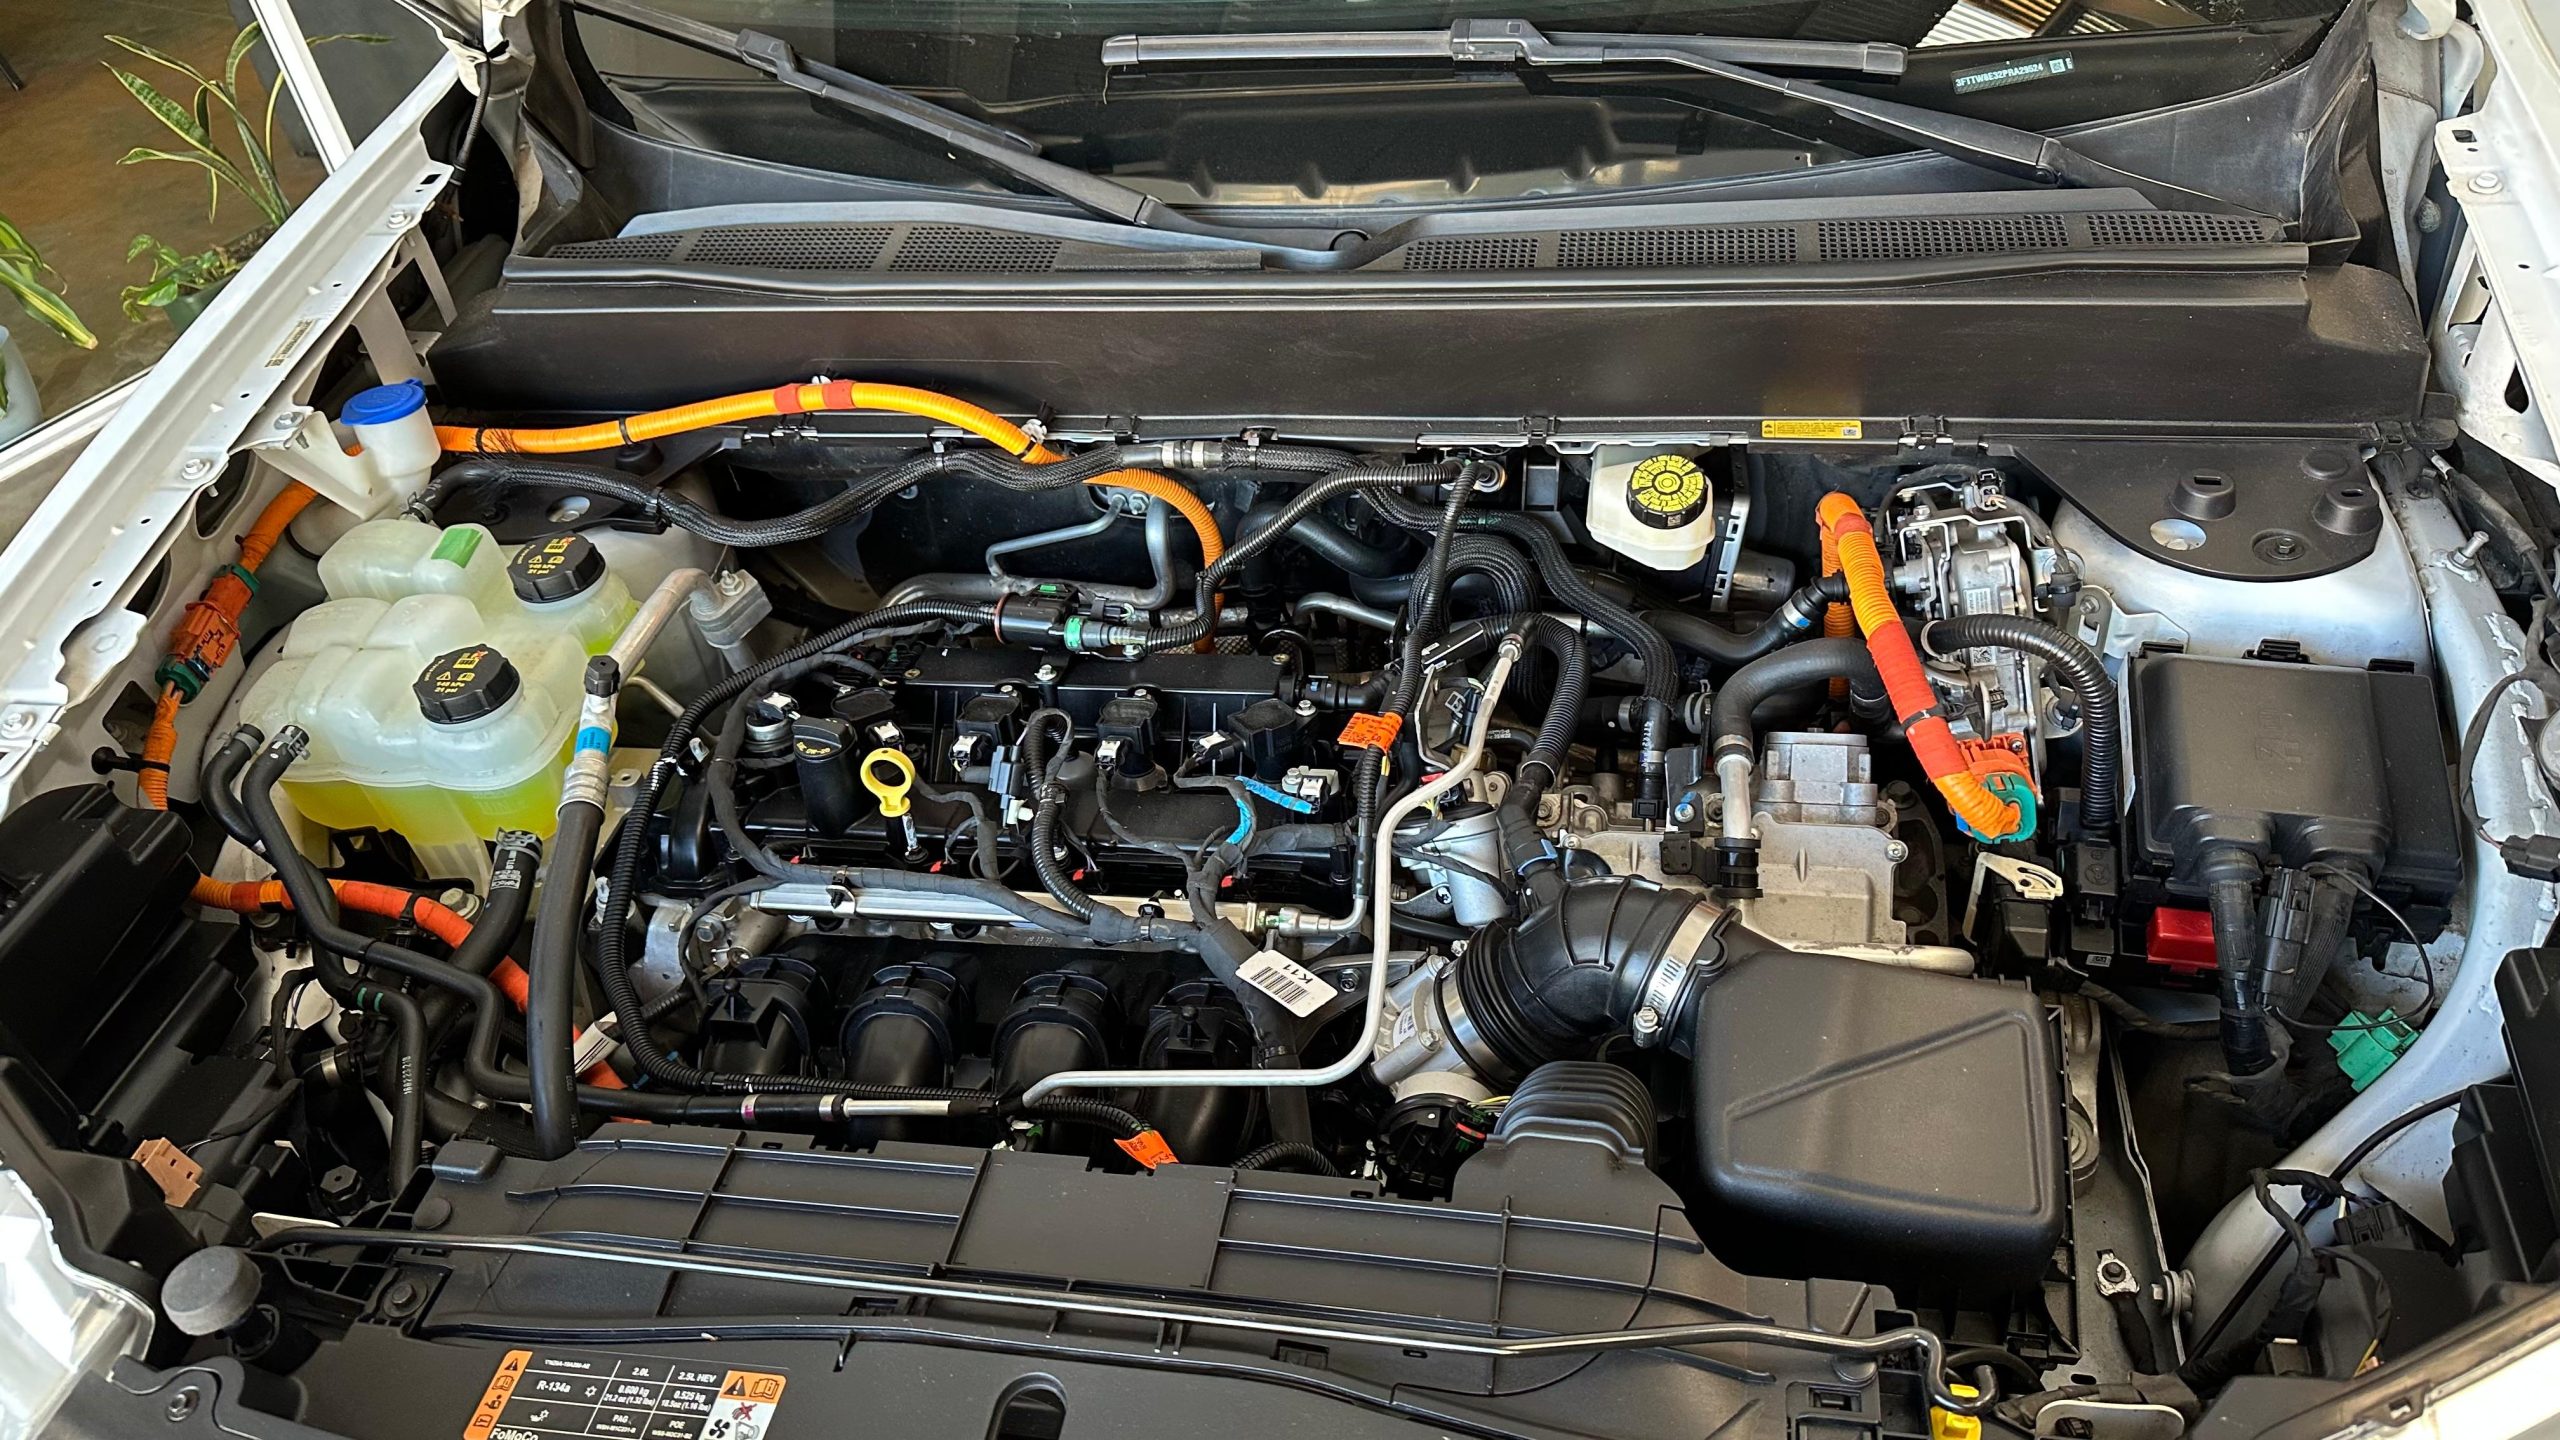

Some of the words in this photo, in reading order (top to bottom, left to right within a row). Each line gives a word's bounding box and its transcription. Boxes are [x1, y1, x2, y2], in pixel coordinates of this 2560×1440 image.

[1955, 63, 2044, 87] 3FTTW8E32PRA29524
[1283, 964, 1313, 984] K11
[631, 1367, 650, 1377] 2.0L
[677, 1371, 696, 1381] 2.5L
[696, 1373, 717, 1383] HEV
[536, 1380, 571, 1393] R-134a
[639, 1386, 650, 1398] kg
[673, 1390, 695, 1401] 0.525
[695, 1392, 706, 1403] kg
[612, 1414, 629, 1424] PAG
[669, 1420, 686, 1429] POE
[489, 1428, 539, 1440] FoMoCo
